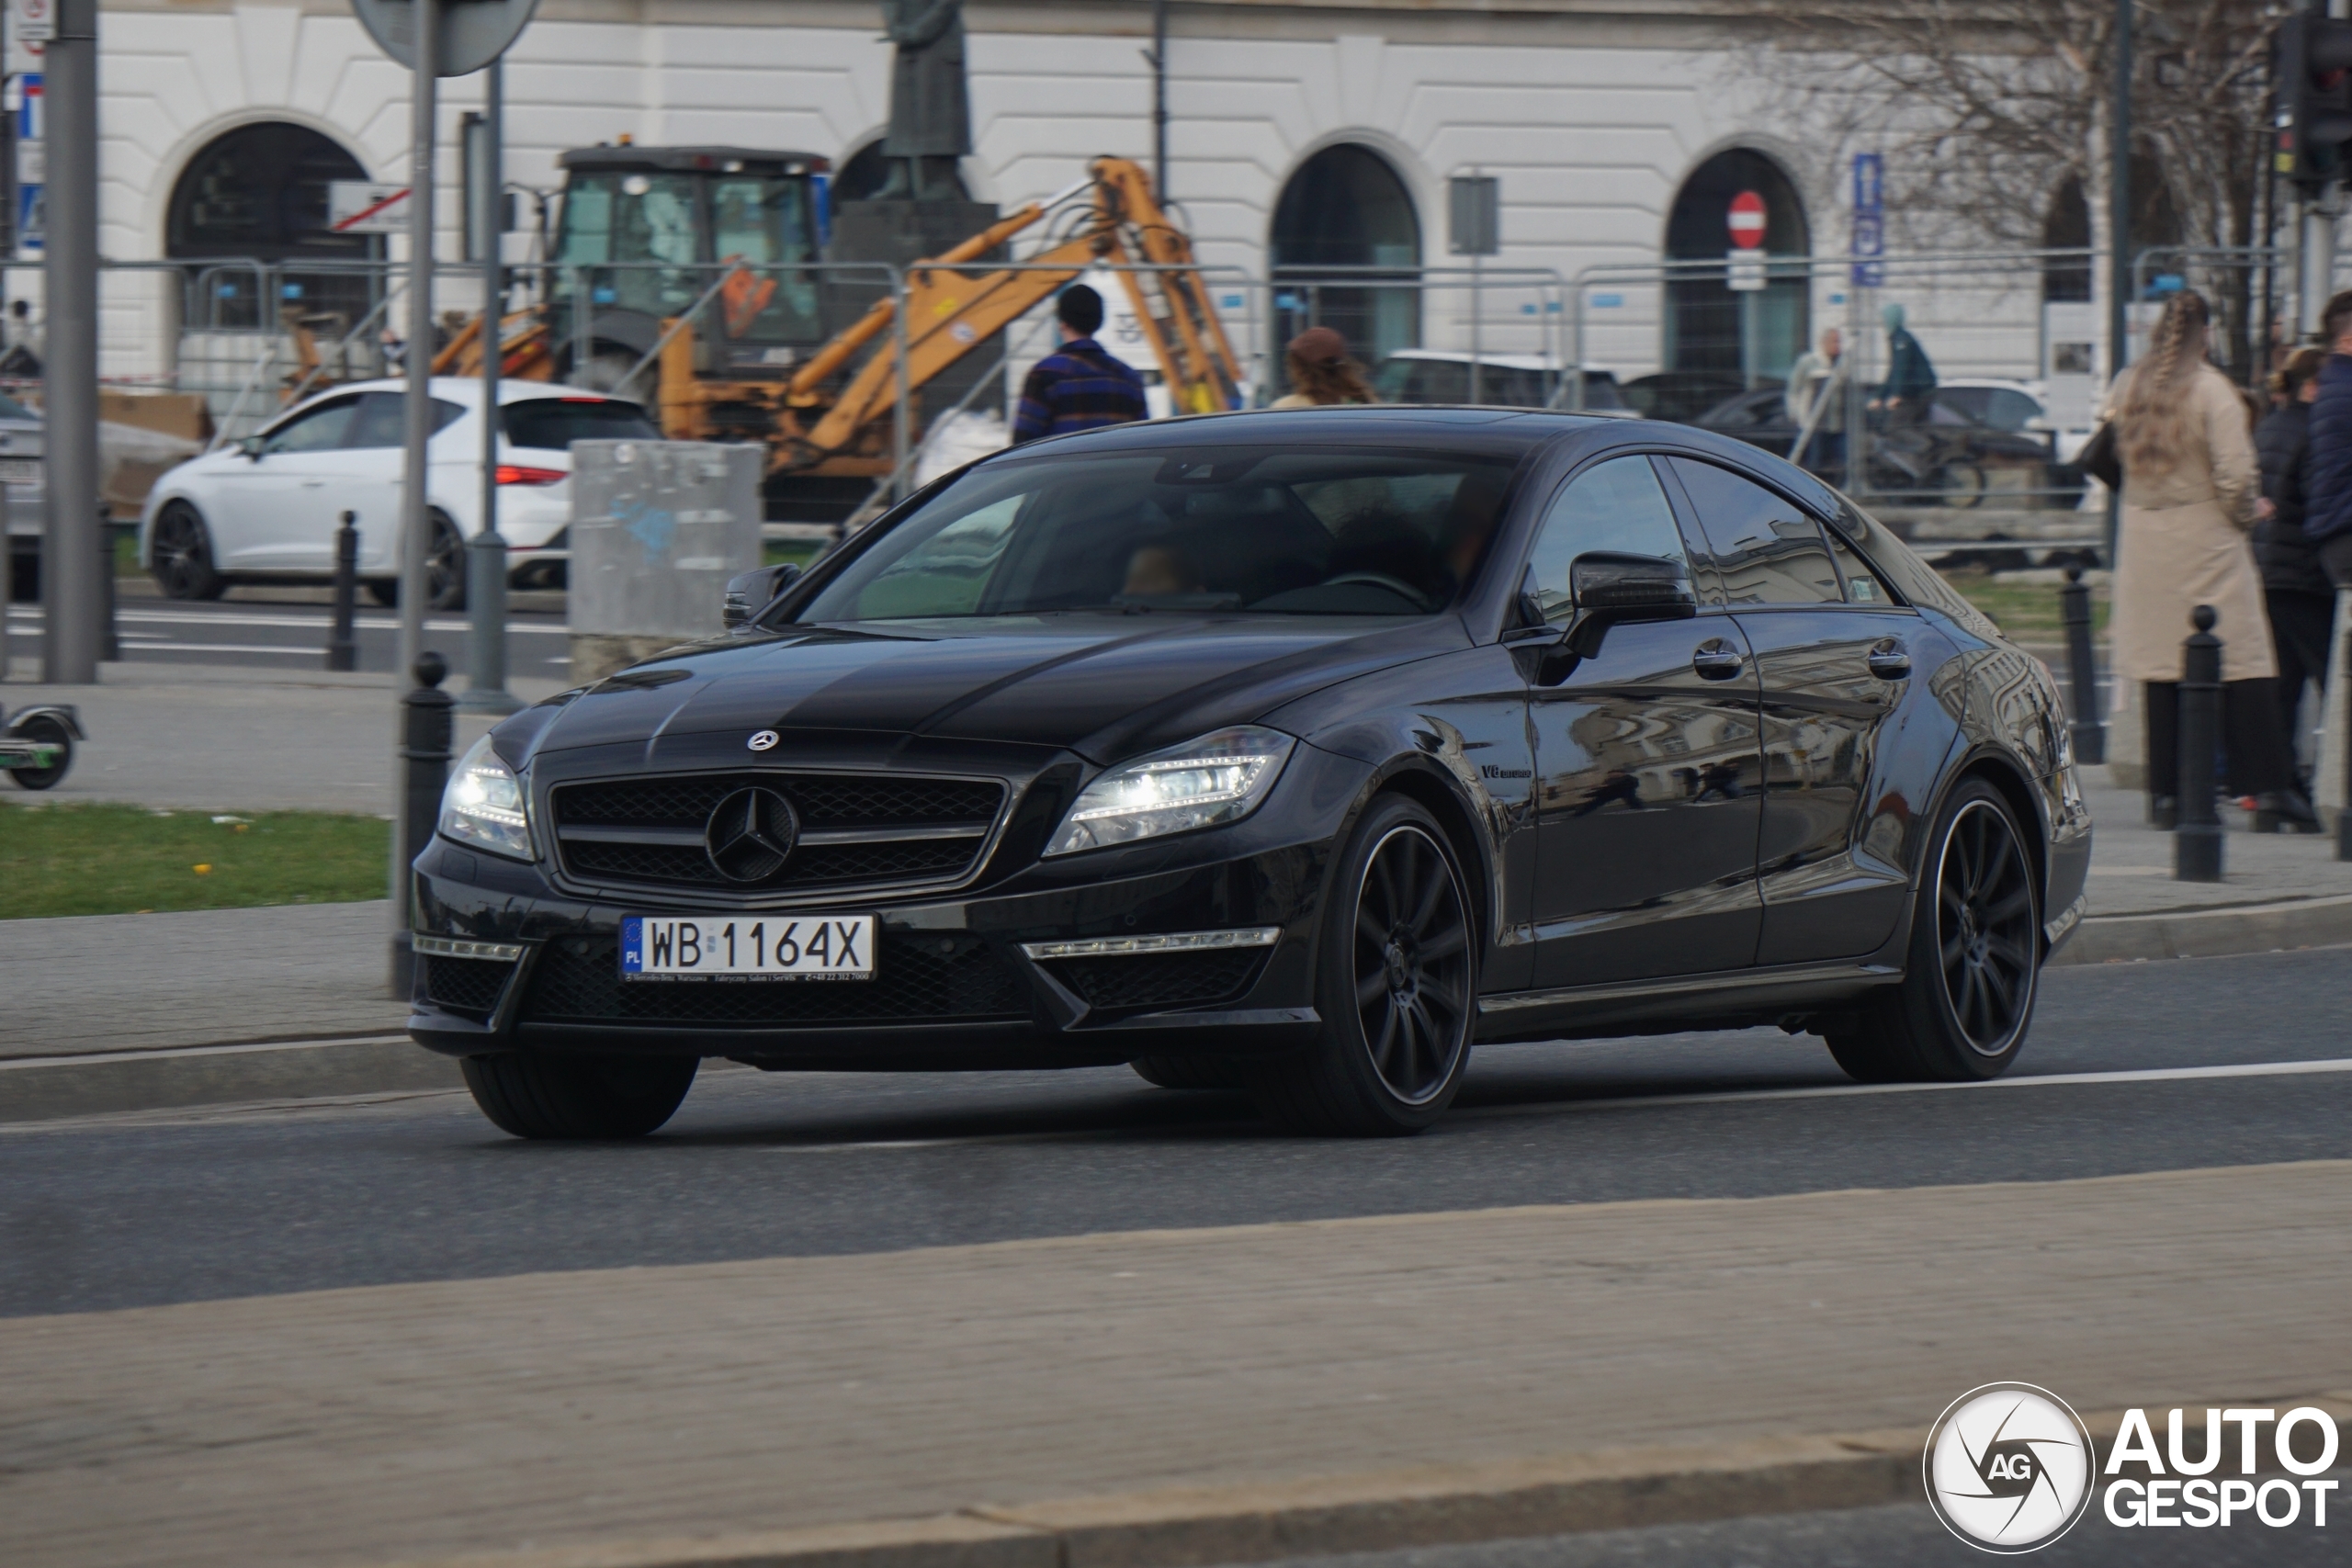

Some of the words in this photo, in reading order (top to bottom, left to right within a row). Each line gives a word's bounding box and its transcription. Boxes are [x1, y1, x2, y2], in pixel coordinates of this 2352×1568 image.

[1481, 765, 1499, 779] V8
[651, 922, 702, 967] WB
[722, 921, 862, 967] 1164X
[626, 952, 640, 964] PL
[773, 974, 796, 982] Serwis
[837, 973, 850, 981] 312
[851, 972, 869, 981] 7000
